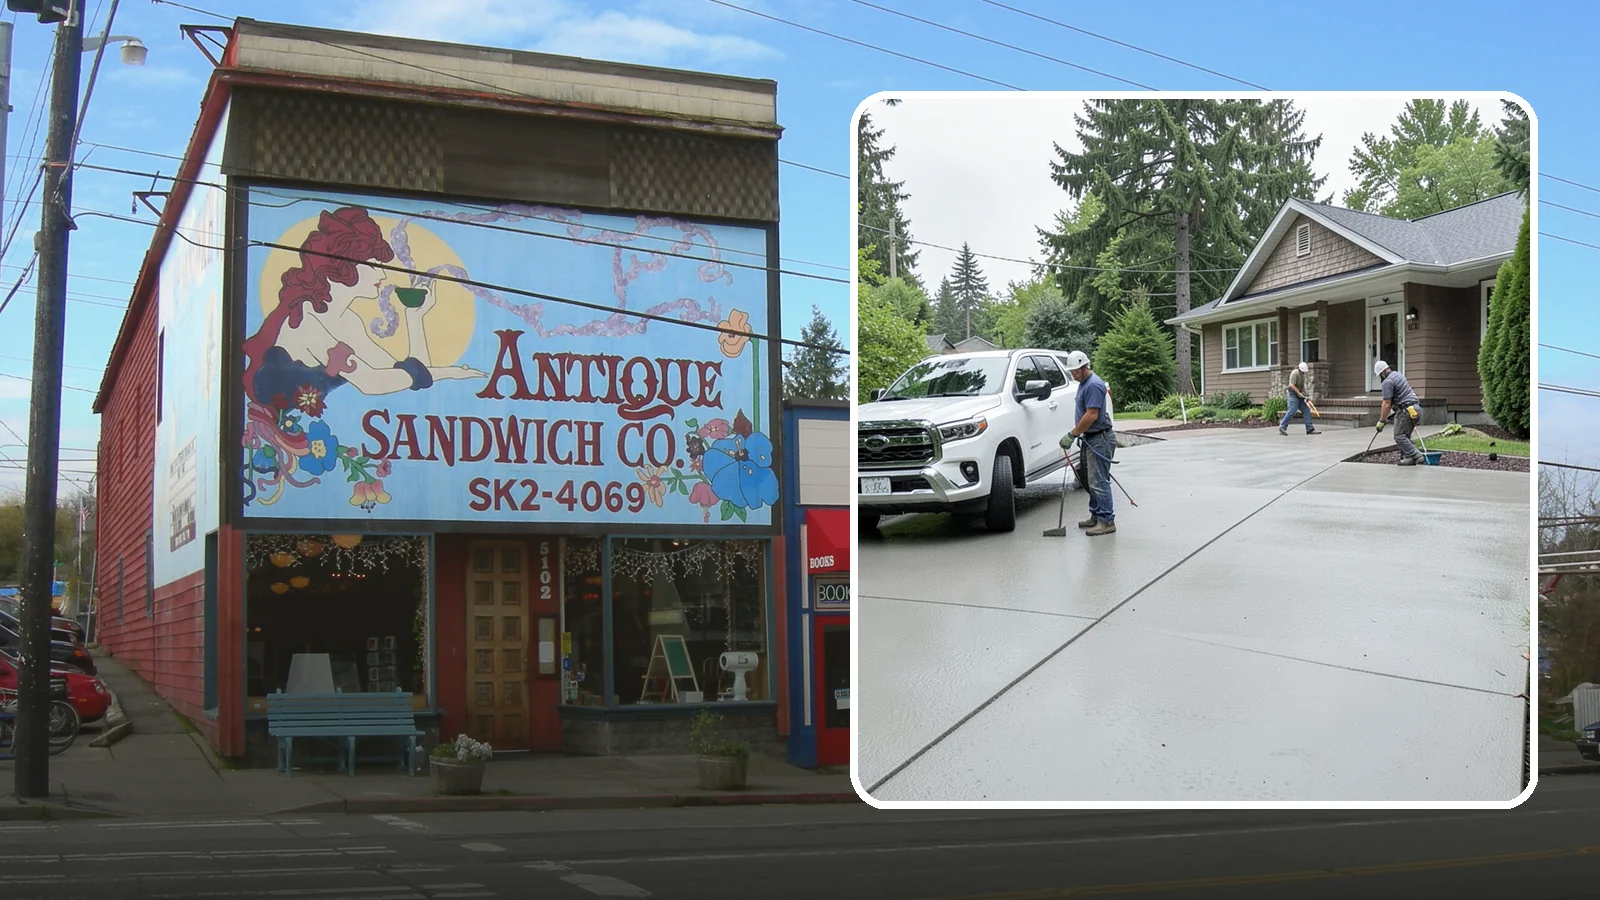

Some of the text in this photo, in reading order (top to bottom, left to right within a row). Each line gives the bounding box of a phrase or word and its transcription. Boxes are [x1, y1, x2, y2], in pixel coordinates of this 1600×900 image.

[476, 329, 724, 421] ANTIQUE
[361, 409, 685, 468] SANDWICH CO.
[469, 477, 646, 512] SK2-4069
[540, 541, 552, 600] 5102
[809, 555, 835, 569] BOOKS
